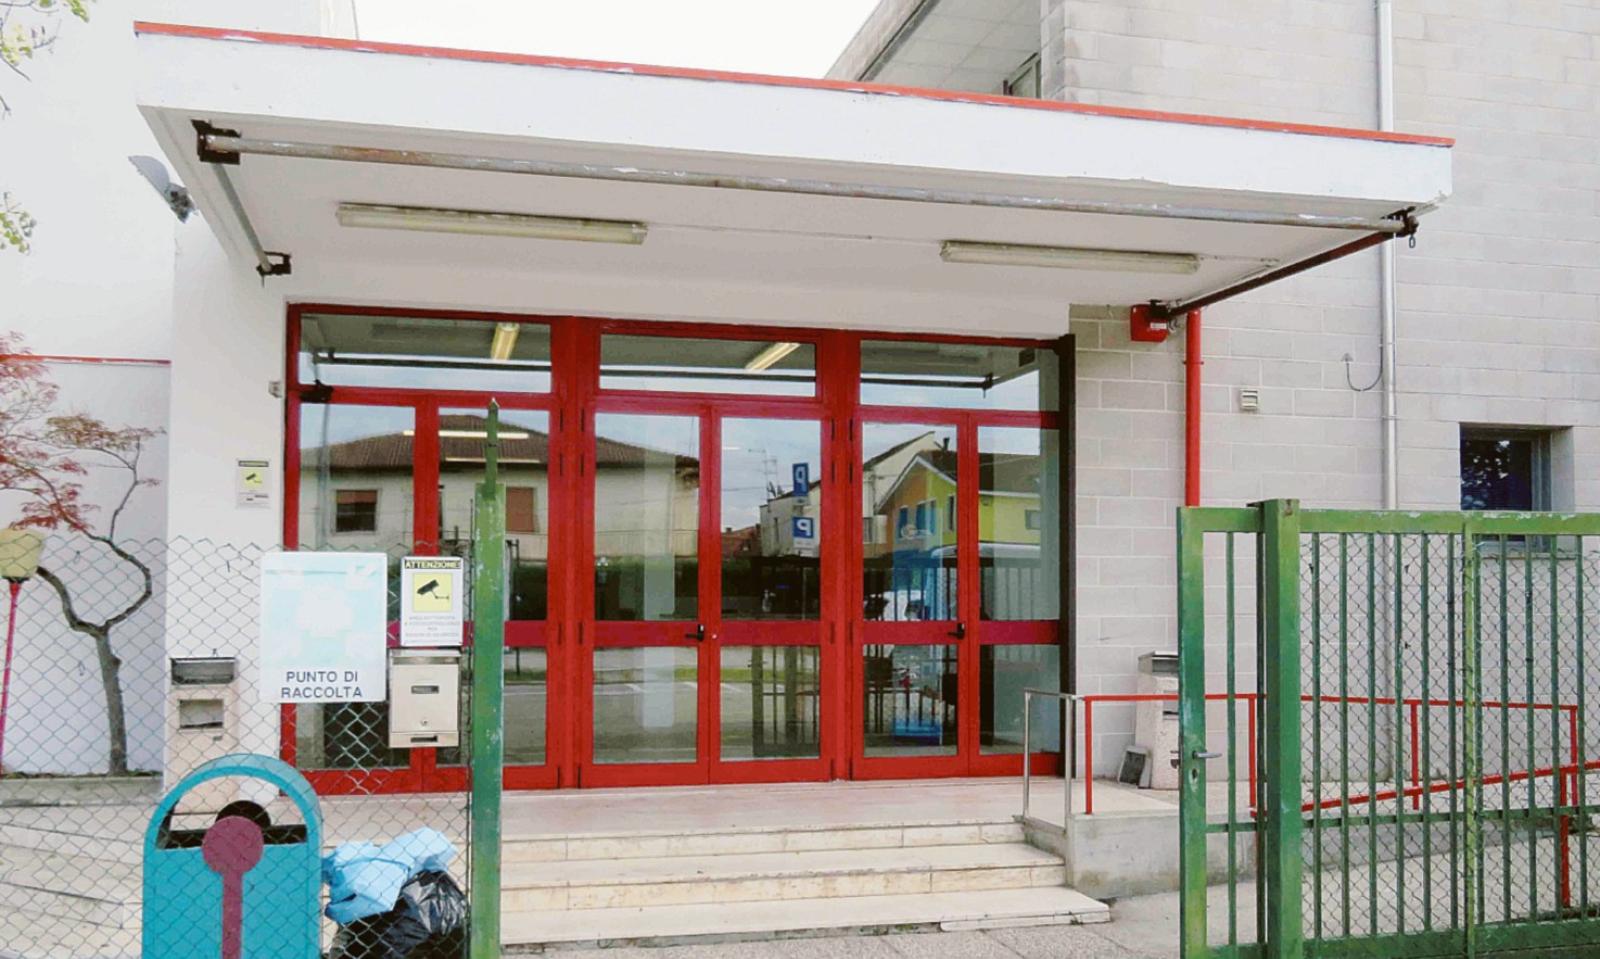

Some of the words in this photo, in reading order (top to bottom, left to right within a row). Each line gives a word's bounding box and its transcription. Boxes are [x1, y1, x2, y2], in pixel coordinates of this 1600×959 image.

[286, 671, 338, 683] PUNTO
[344, 671, 358, 682] DI
[281, 686, 362, 698] RACCOLTA
